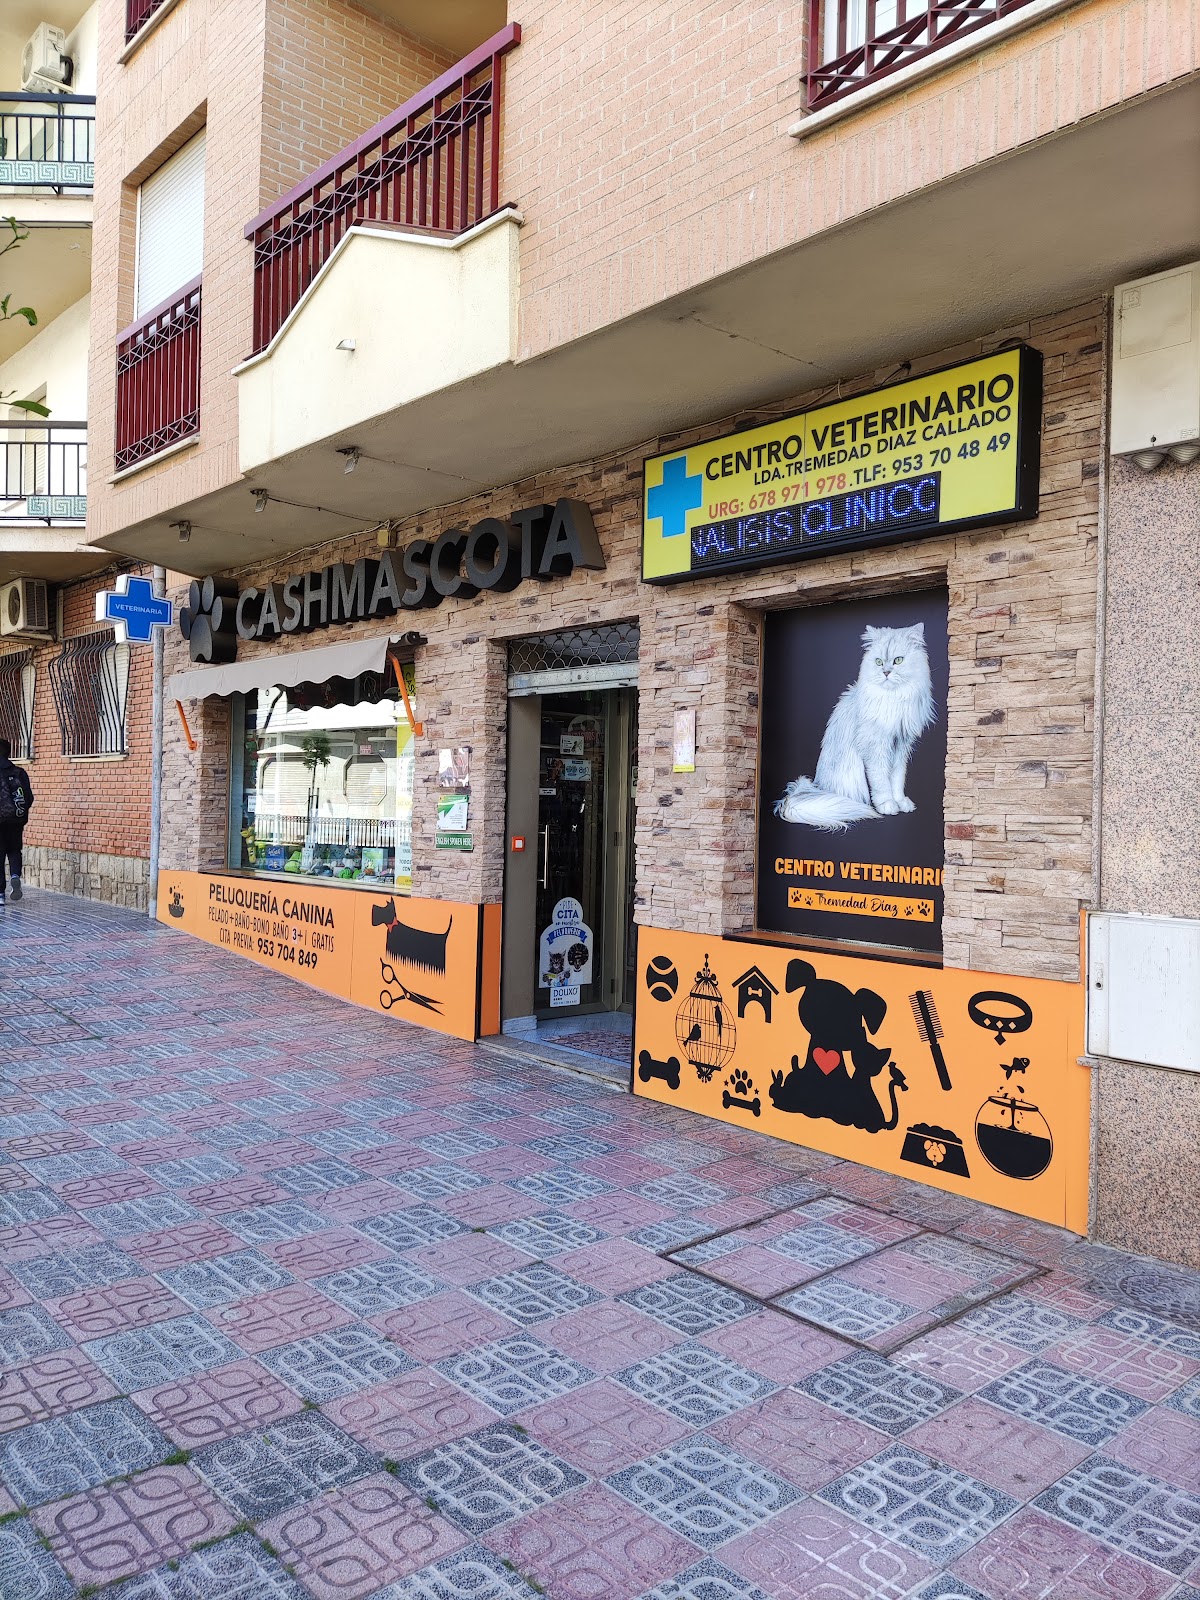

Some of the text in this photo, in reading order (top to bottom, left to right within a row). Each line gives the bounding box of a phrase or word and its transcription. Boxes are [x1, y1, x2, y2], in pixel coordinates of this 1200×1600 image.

[705, 373, 1014, 481] CENTRO VETERINARIO
[877, 429, 917, 454] DIAZ
[922, 405, 1012, 441] CALLADO
[708, 498, 744, 520] URG:
[749, 491, 777, 511] 678
[781, 482, 809, 505] 971
[892, 454, 923, 476] 953
[930, 446, 951, 466] 70
[957, 438, 981, 460] 48
[986, 432, 1011, 453] 49
[236, 497, 600, 641] CASHMASCOTA
[115, 603, 163, 616] VETERINARIA
[463, 837, 472, 846] HERE
[774, 857, 945, 887] CENTRO VETERINARI
[209, 882, 335, 929] PELUQUERÍA CANINA
[556, 909, 579, 919] CITA
[814, 892, 869, 910] Tremedad
[219, 927, 231, 945] CITA
[257, 937, 275, 957] 953
[277, 942, 295, 963] 704
[298, 948, 318, 970] 849
[272, 919, 289, 941] BAÑO
[311, 931, 335, 953] GRATIS
